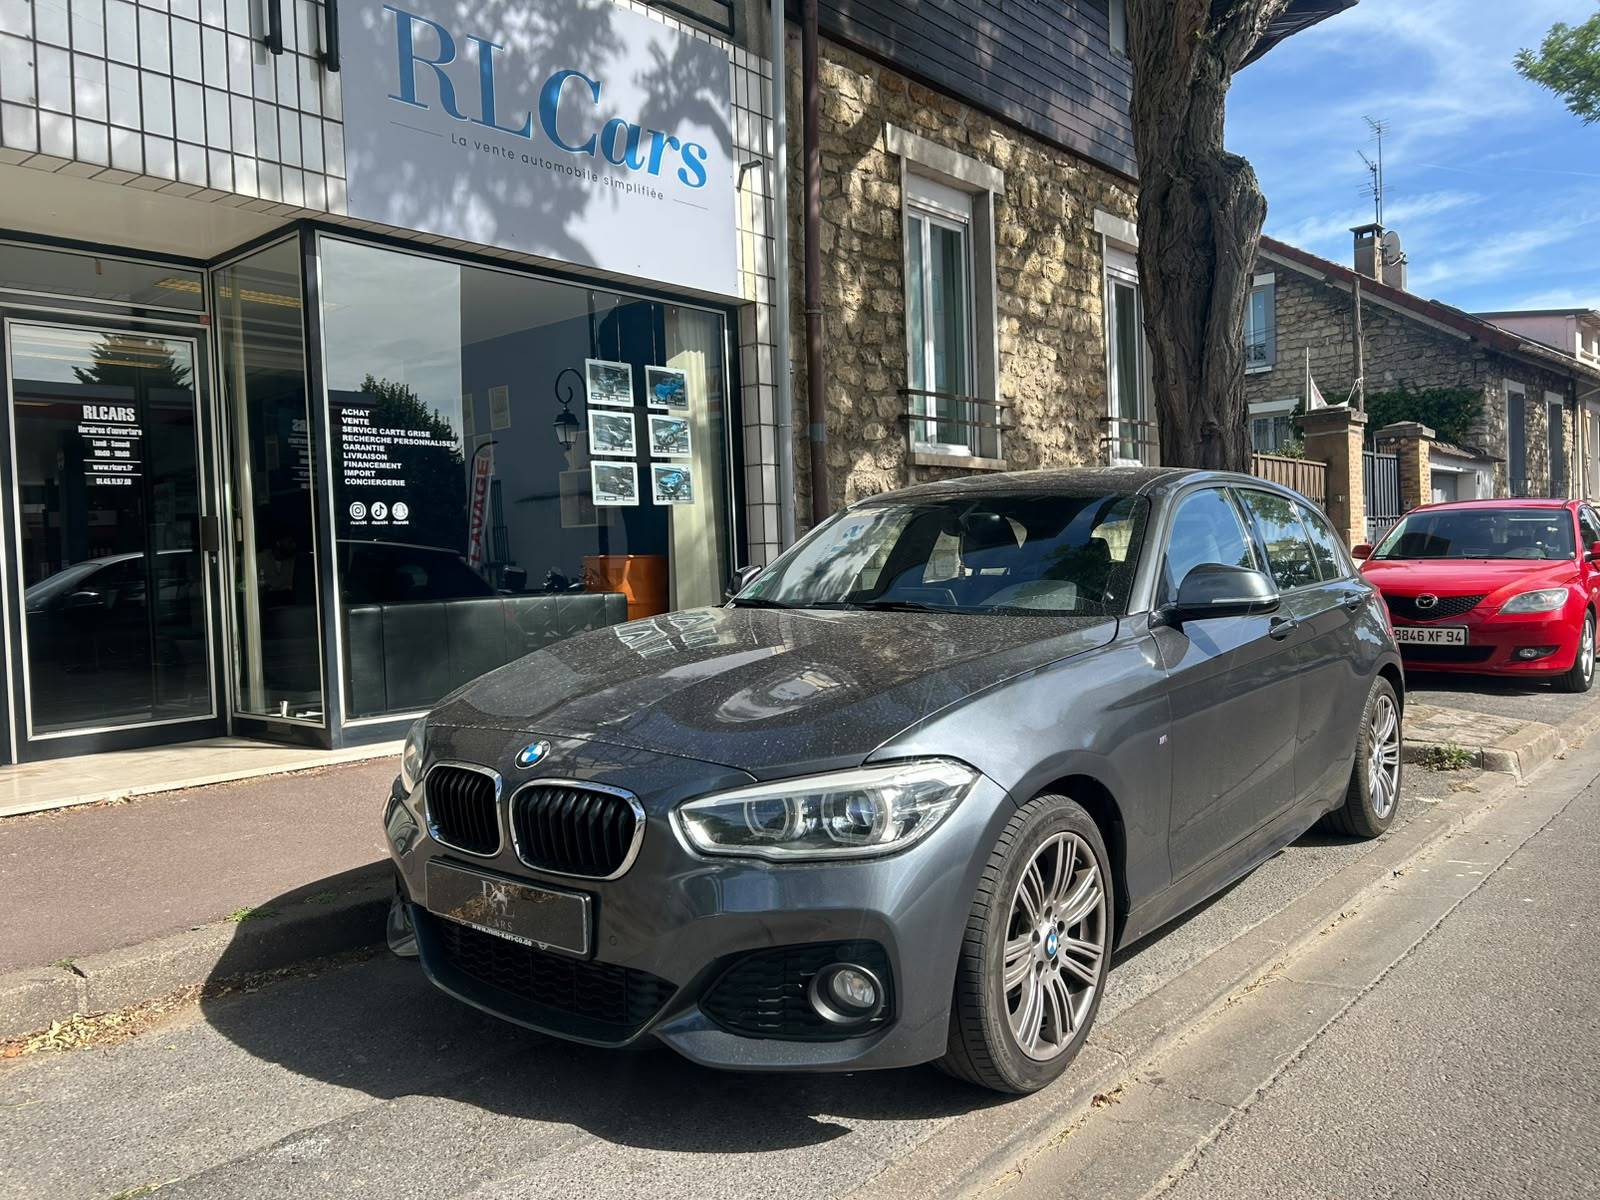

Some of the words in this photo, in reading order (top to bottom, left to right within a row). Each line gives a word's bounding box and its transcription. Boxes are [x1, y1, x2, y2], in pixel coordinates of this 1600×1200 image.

[451, 133, 467, 146] La
[474, 141, 515, 160] vente
[521, 154, 599, 183] automobile
[603, 175, 665, 201] simplifiée
[82, 405, 135, 421] RLCARS
[341, 408, 370, 417] ACHAT
[341, 417, 370, 426] VENTE
[342, 425, 377, 434] SERVICE
[379, 428, 406, 437] CARTE
[407, 430, 431, 438] GRISE
[342, 434, 392, 444] RECHERCHE
[343, 443, 385, 452] GARANTIE
[343, 452, 387, 461] LIVRAISON
[344, 460, 402, 470] FINANCEMENT
[344, 469, 376, 478] IMPORT
[344, 478, 406, 487] CONCIERGERIE
[1427, 630, 1443, 642] XF
[1446, 631, 1463, 642] 94
